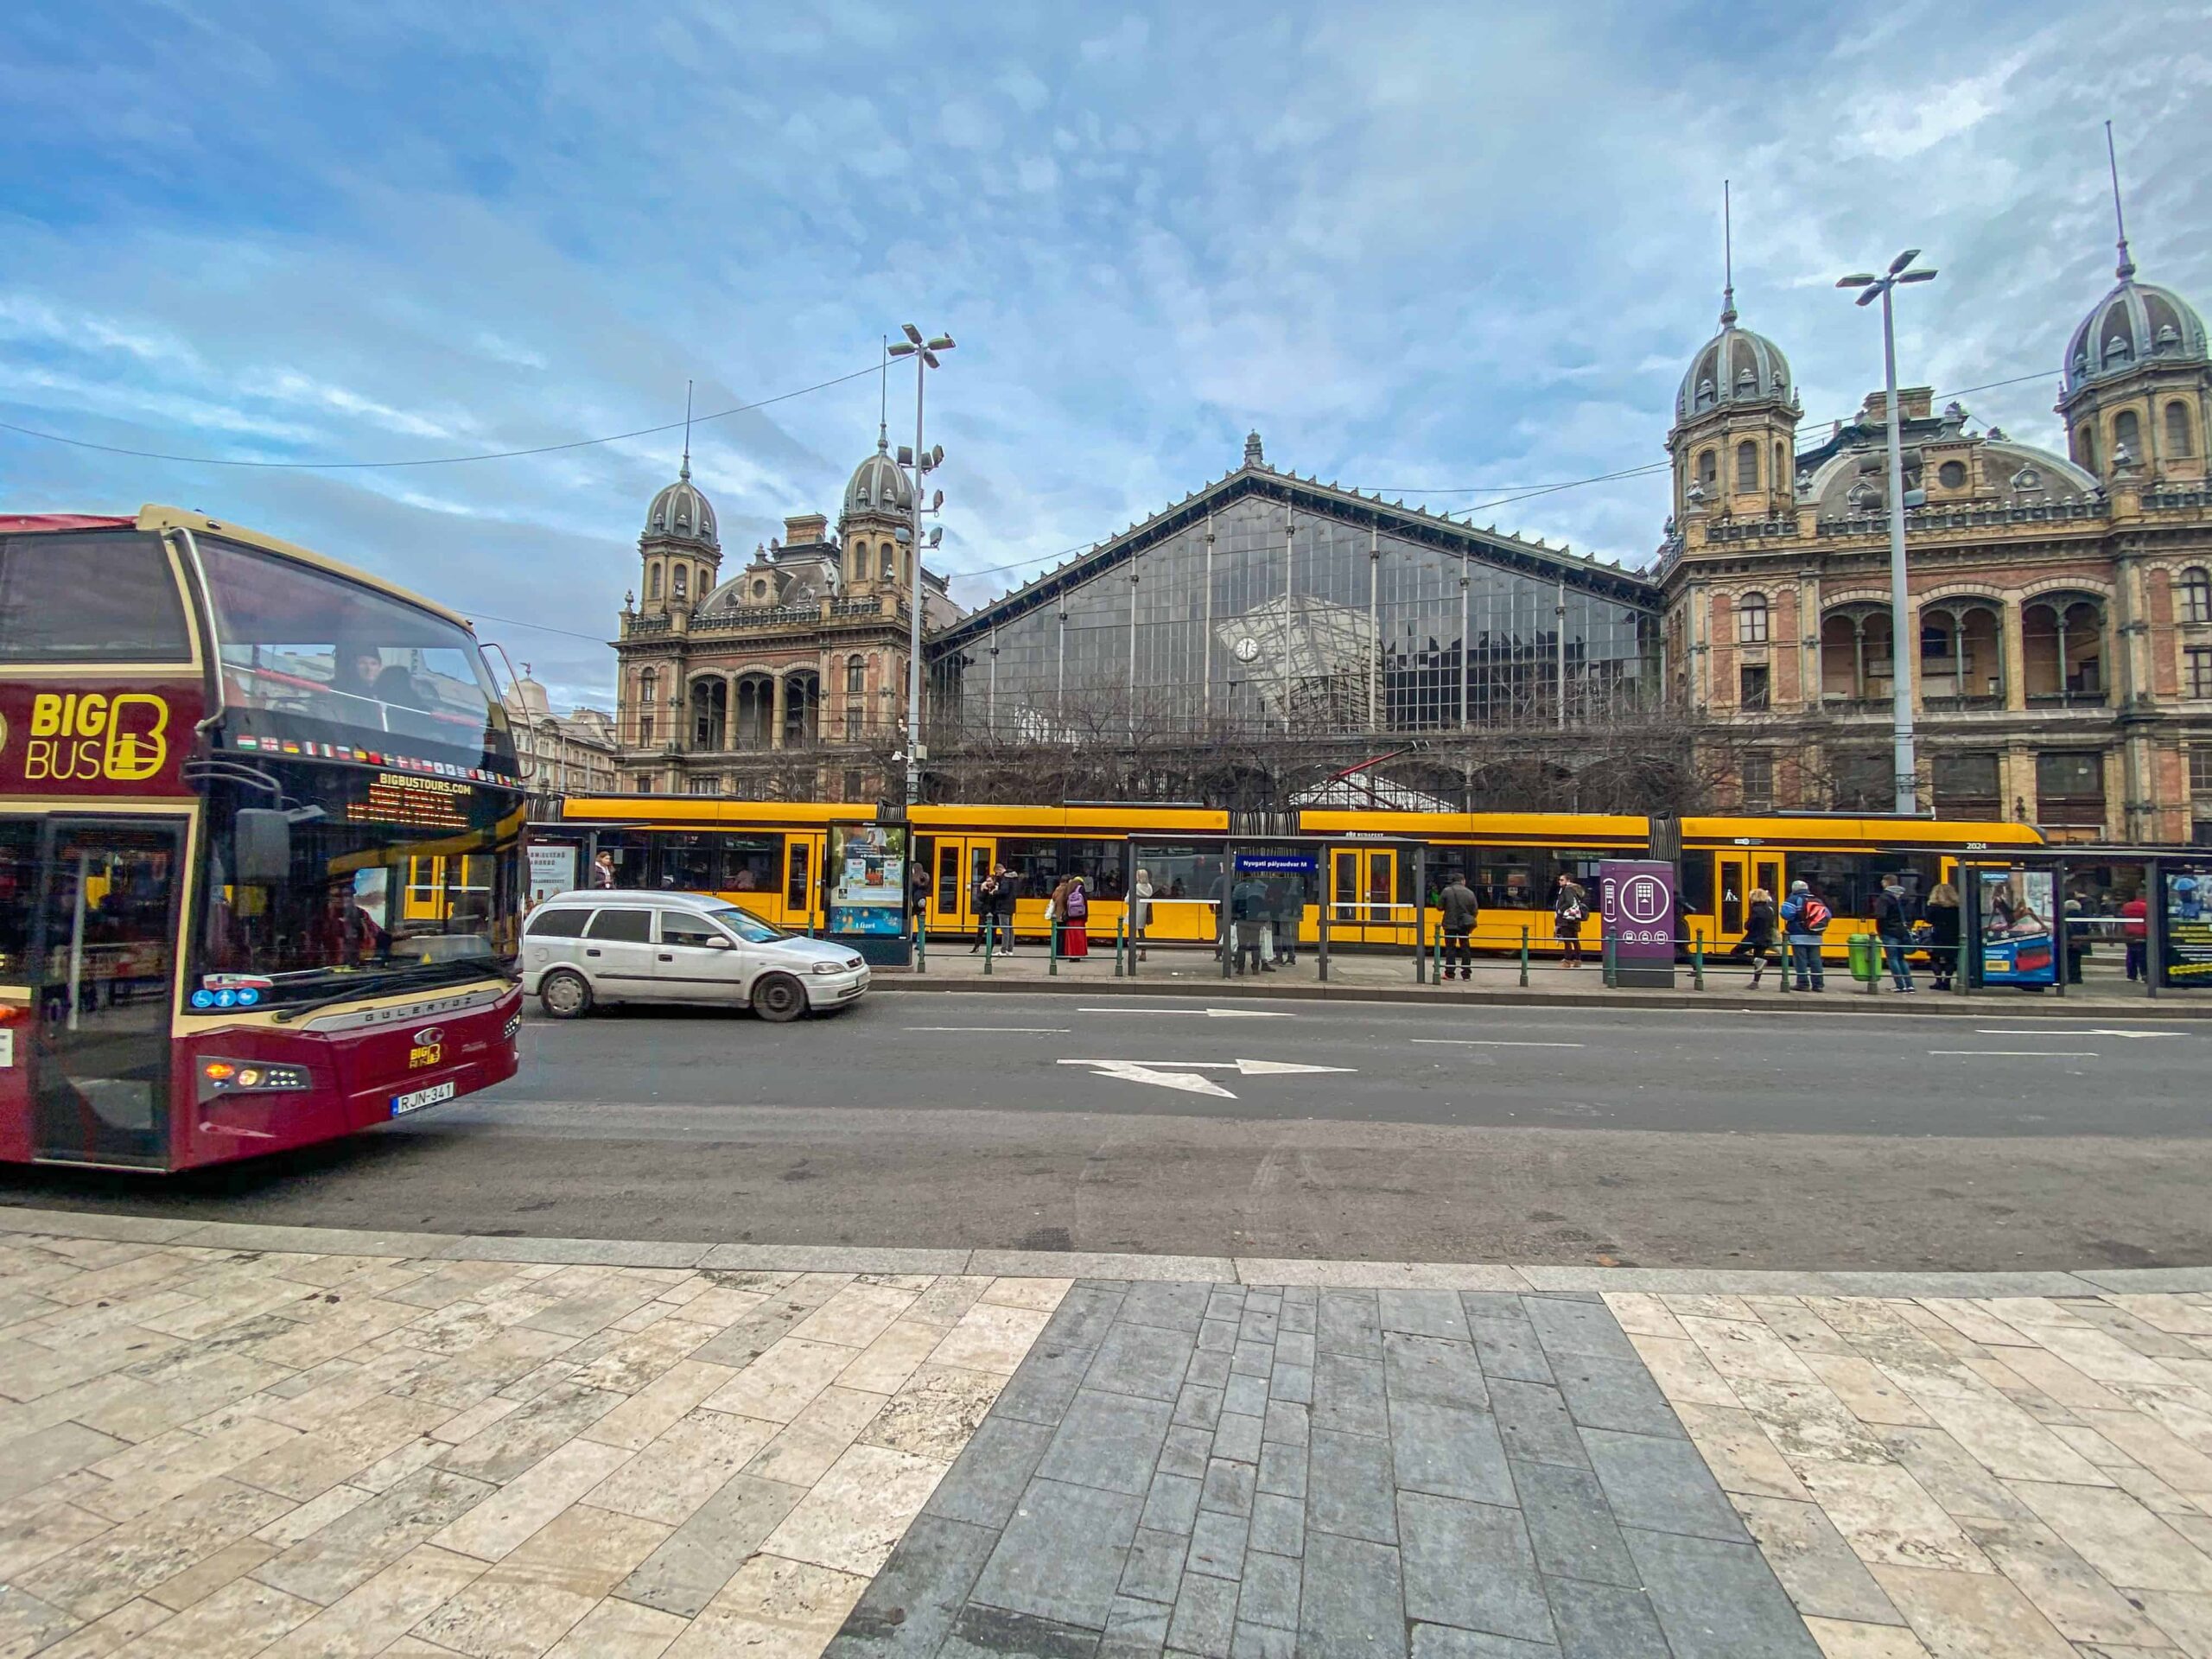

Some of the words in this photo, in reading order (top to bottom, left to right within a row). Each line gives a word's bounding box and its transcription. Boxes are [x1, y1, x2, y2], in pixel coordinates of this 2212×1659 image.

[31, 694, 107, 736] BIG
[25, 741, 101, 779] BUS
[379, 773, 472, 795] BIGBUSTOURS.COM
[410, 1046, 429, 1060] BIG
[401, 1084, 451, 1110] RJN-341
